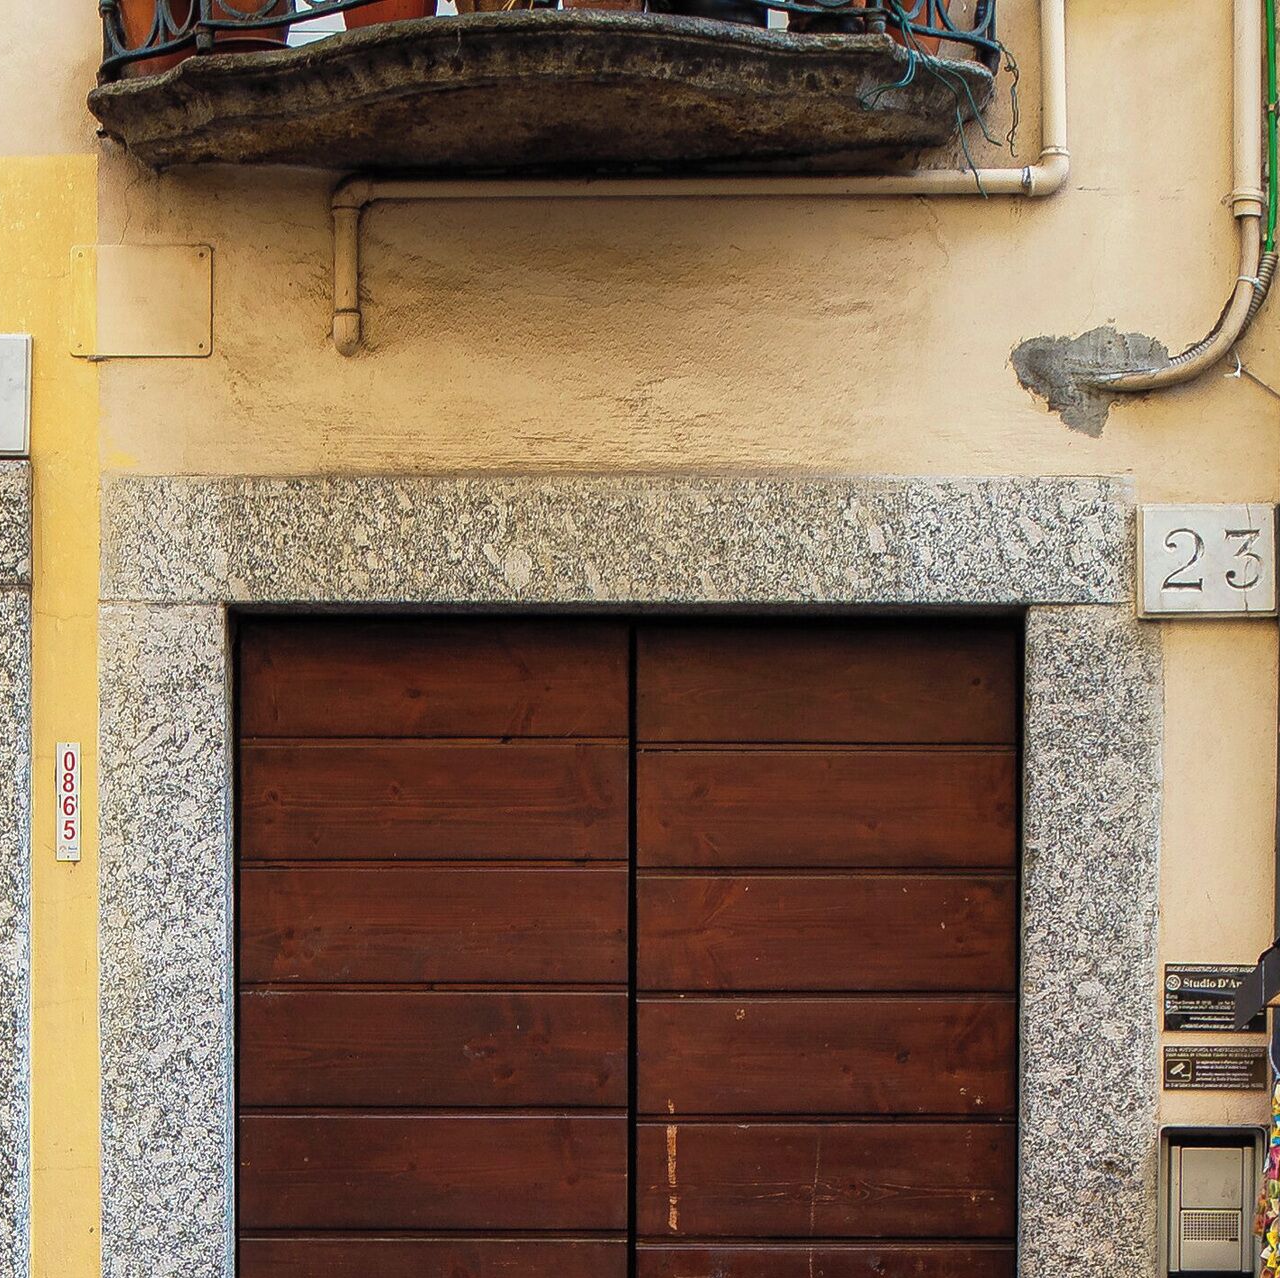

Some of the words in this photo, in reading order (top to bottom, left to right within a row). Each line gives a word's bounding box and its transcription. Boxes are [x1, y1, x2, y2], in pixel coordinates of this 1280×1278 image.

[1161, 528, 1262, 592] 23
[63, 751, 76, 840] 0865
[1183, 978, 1216, 988] Studio
